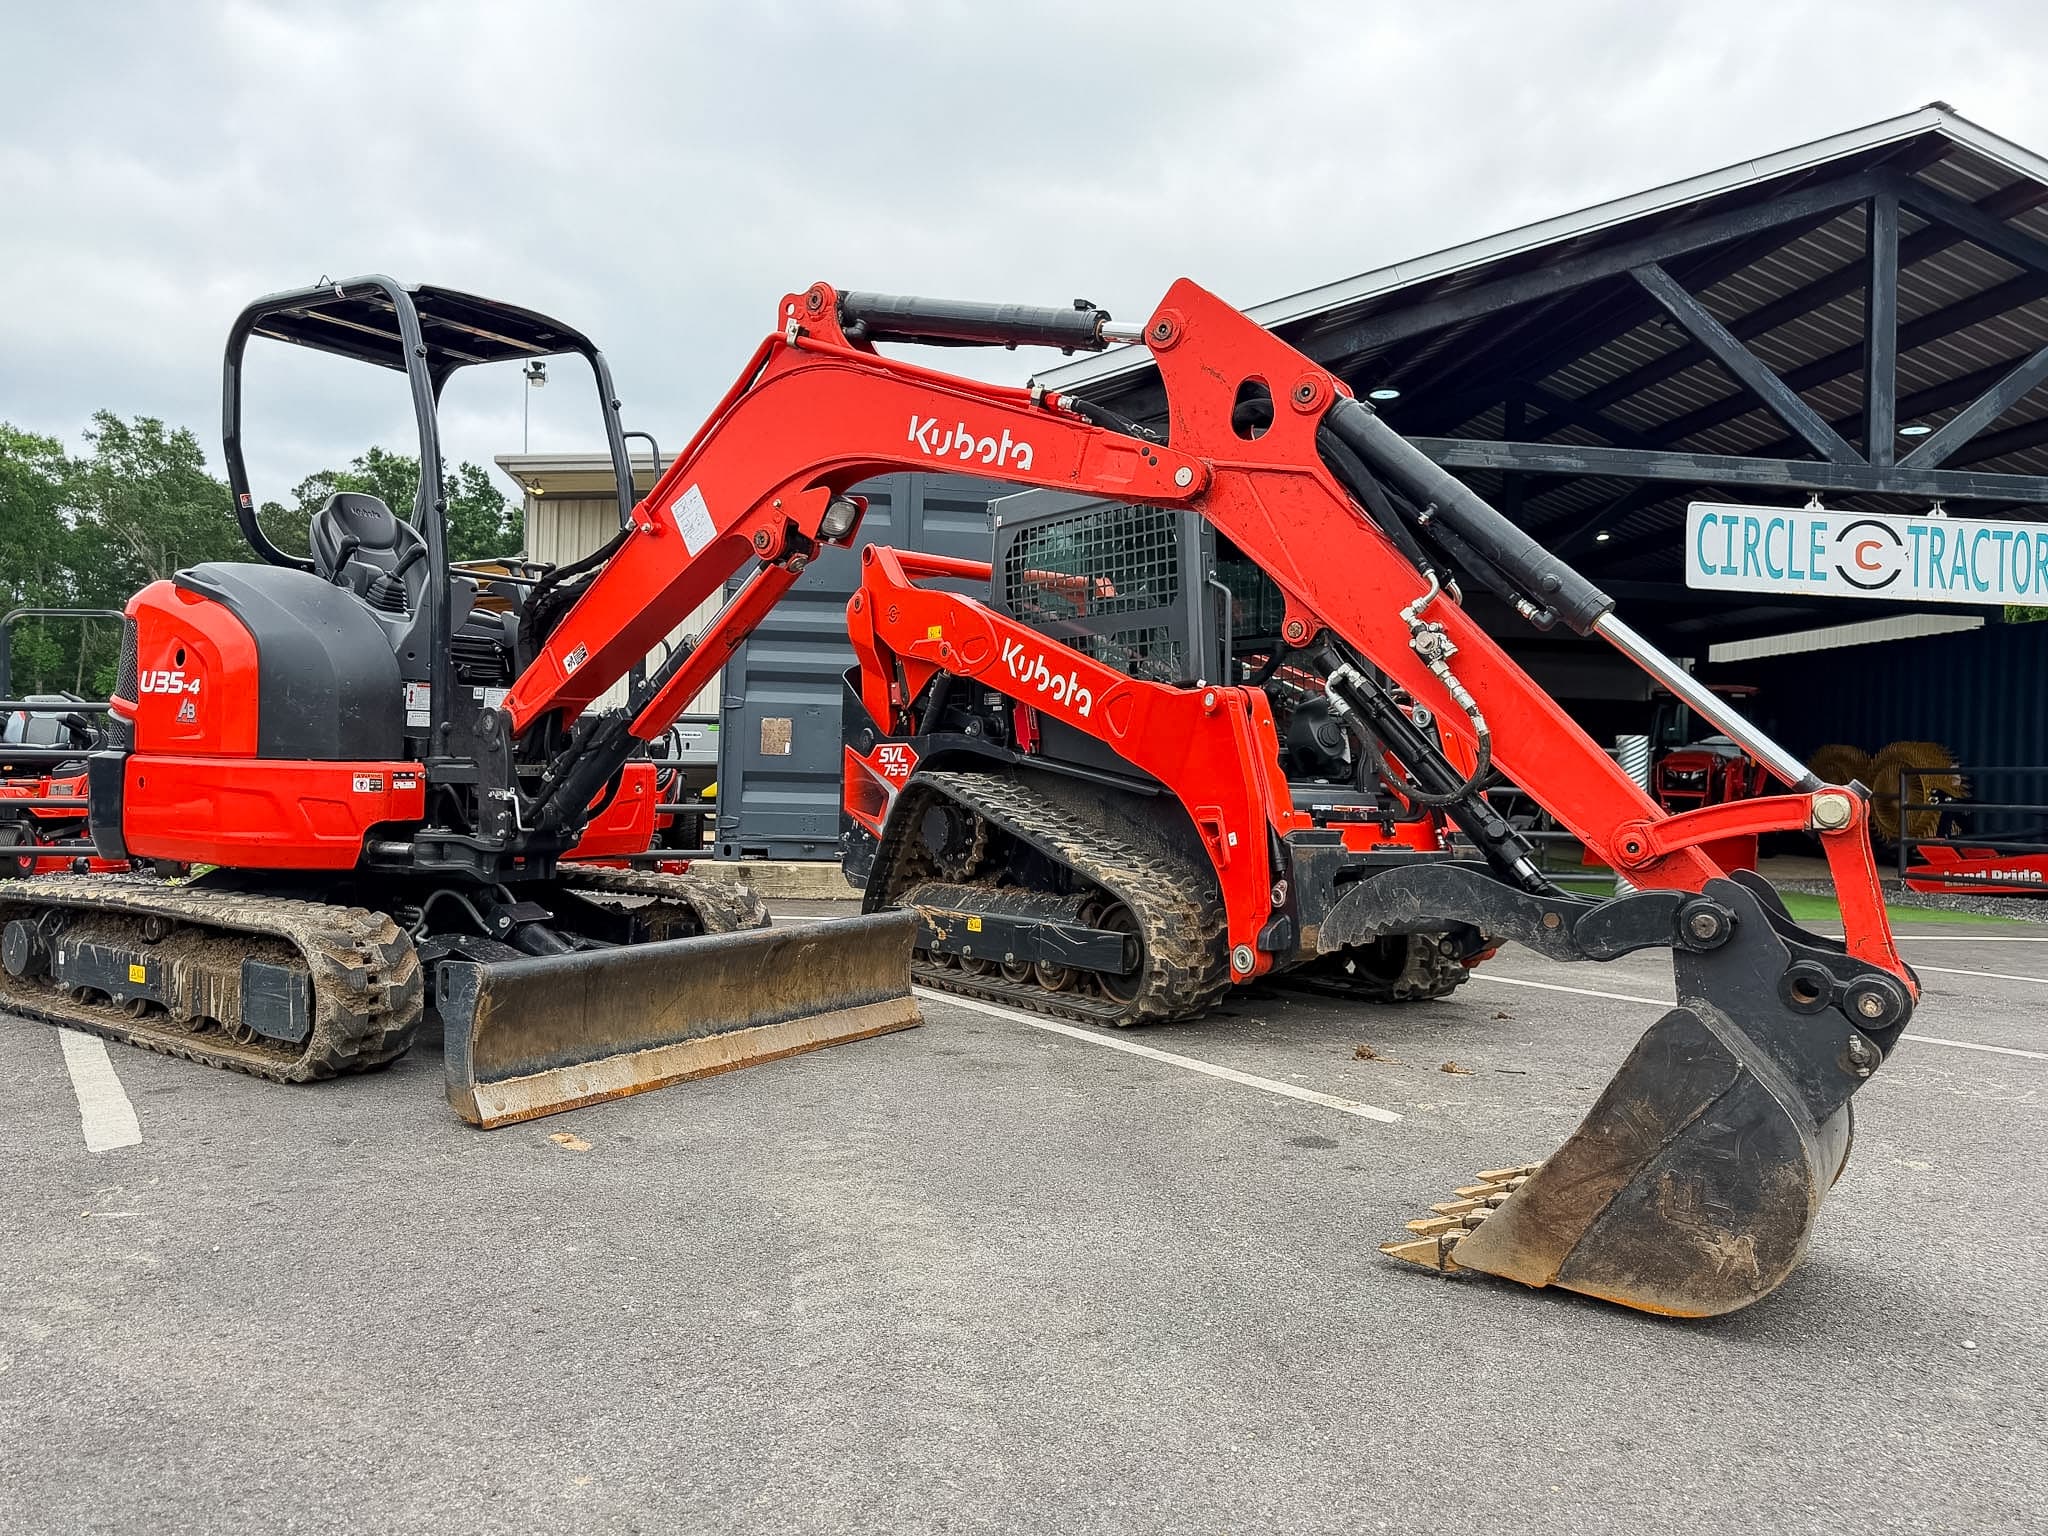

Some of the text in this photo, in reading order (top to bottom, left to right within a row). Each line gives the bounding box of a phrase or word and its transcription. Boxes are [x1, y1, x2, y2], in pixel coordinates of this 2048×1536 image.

[907, 415, 1034, 470] Kubota
[1696, 512, 1829, 582] CIRCLE
[1906, 524, 2048, 595] TRACTOR
[140, 670, 200, 695] U35-4
[1001, 637, 1092, 717] Kubota
[878, 746, 907, 763] SVL
[883, 763, 909, 777] 75-3
